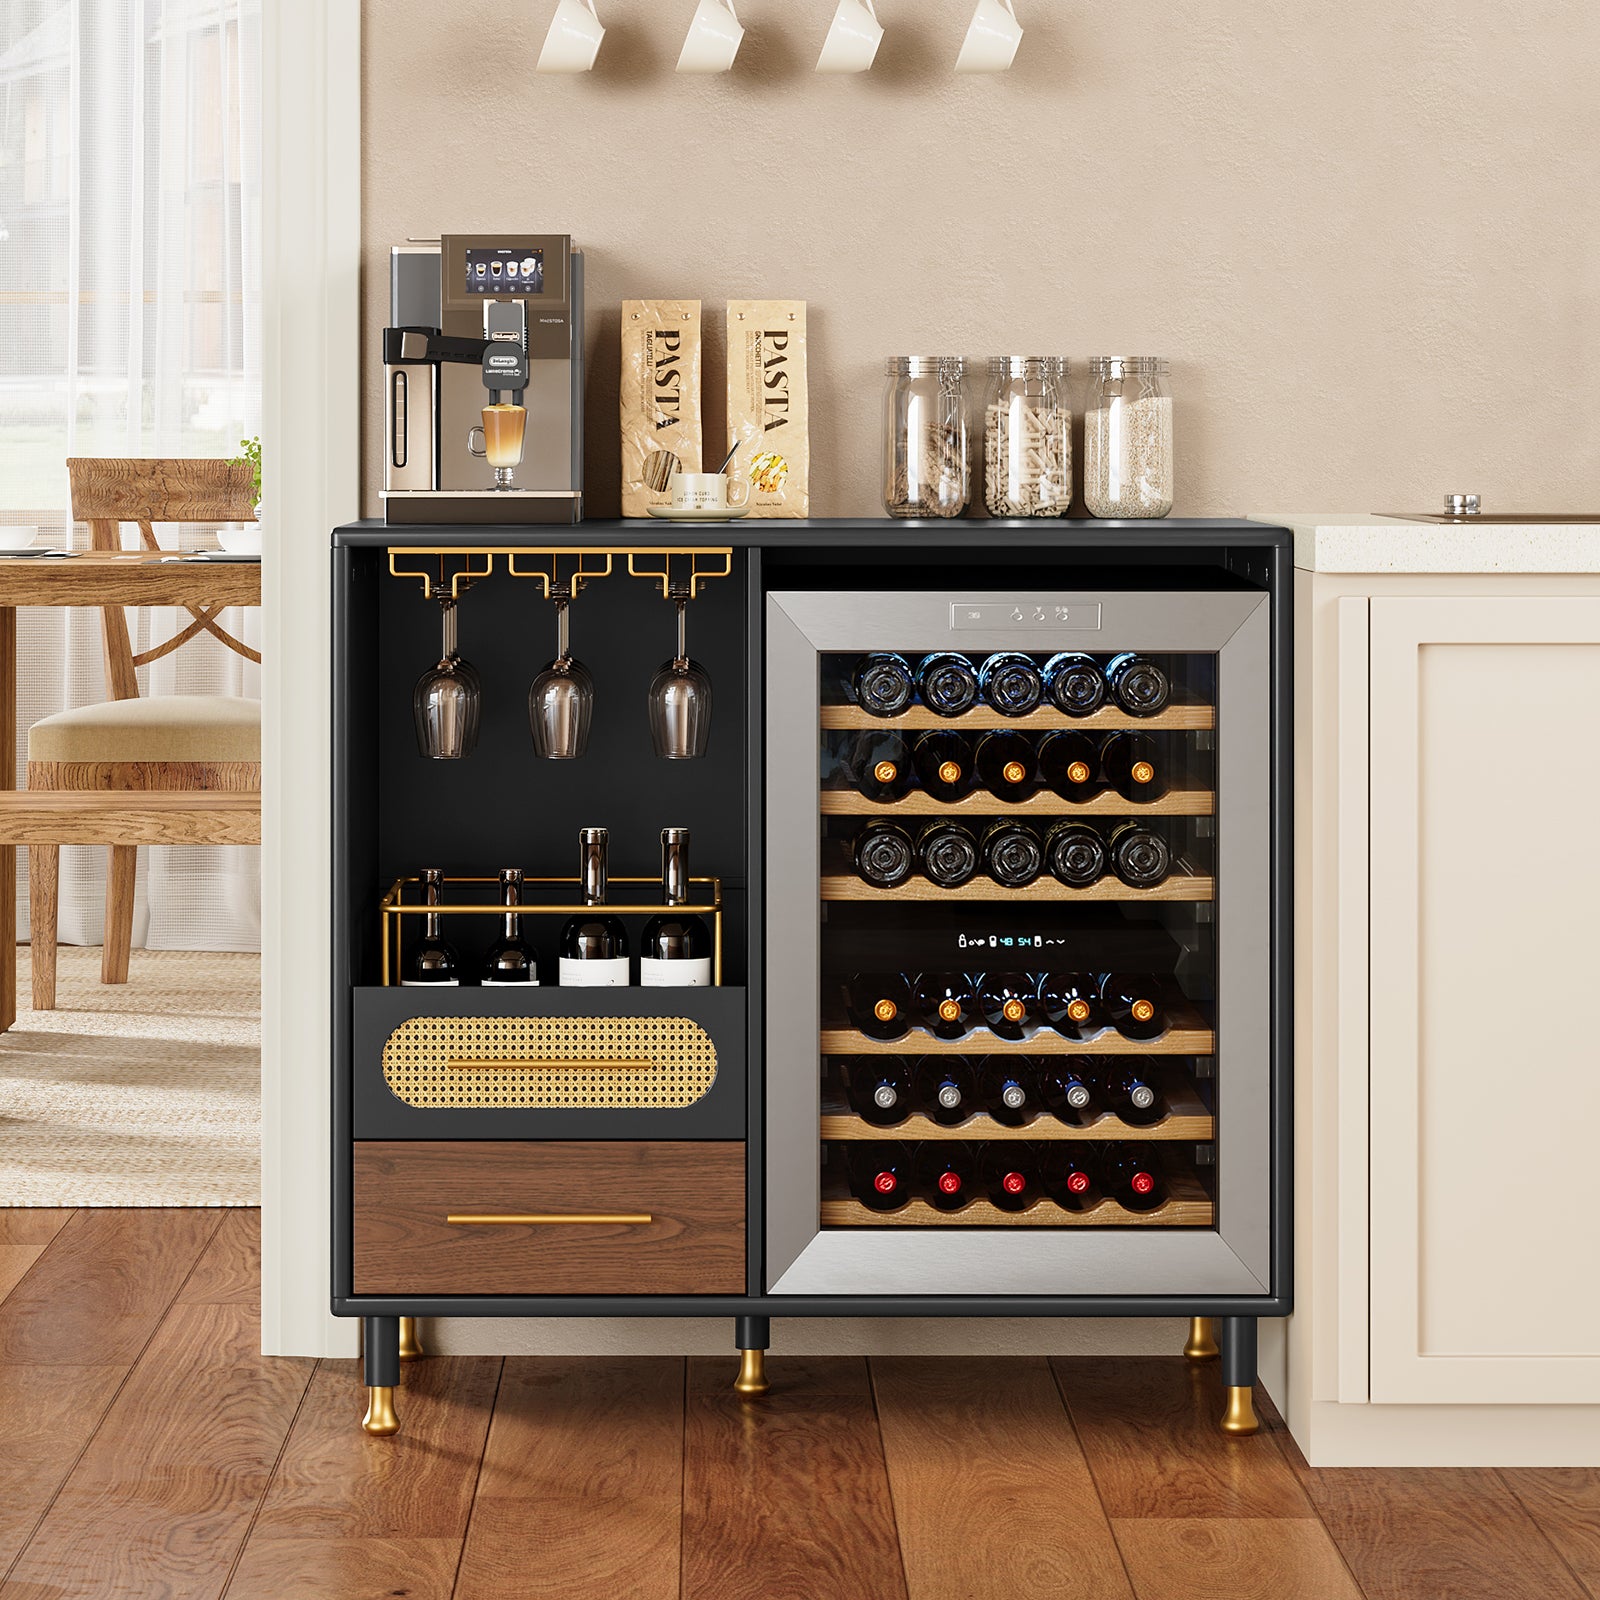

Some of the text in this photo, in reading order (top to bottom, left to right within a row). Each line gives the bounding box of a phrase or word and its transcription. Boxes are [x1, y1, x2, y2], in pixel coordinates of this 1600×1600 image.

[655, 329, 681, 432] PASTA
[763, 330, 789, 432] PASTA
[1000, 938, 1032, 946] 48 54
